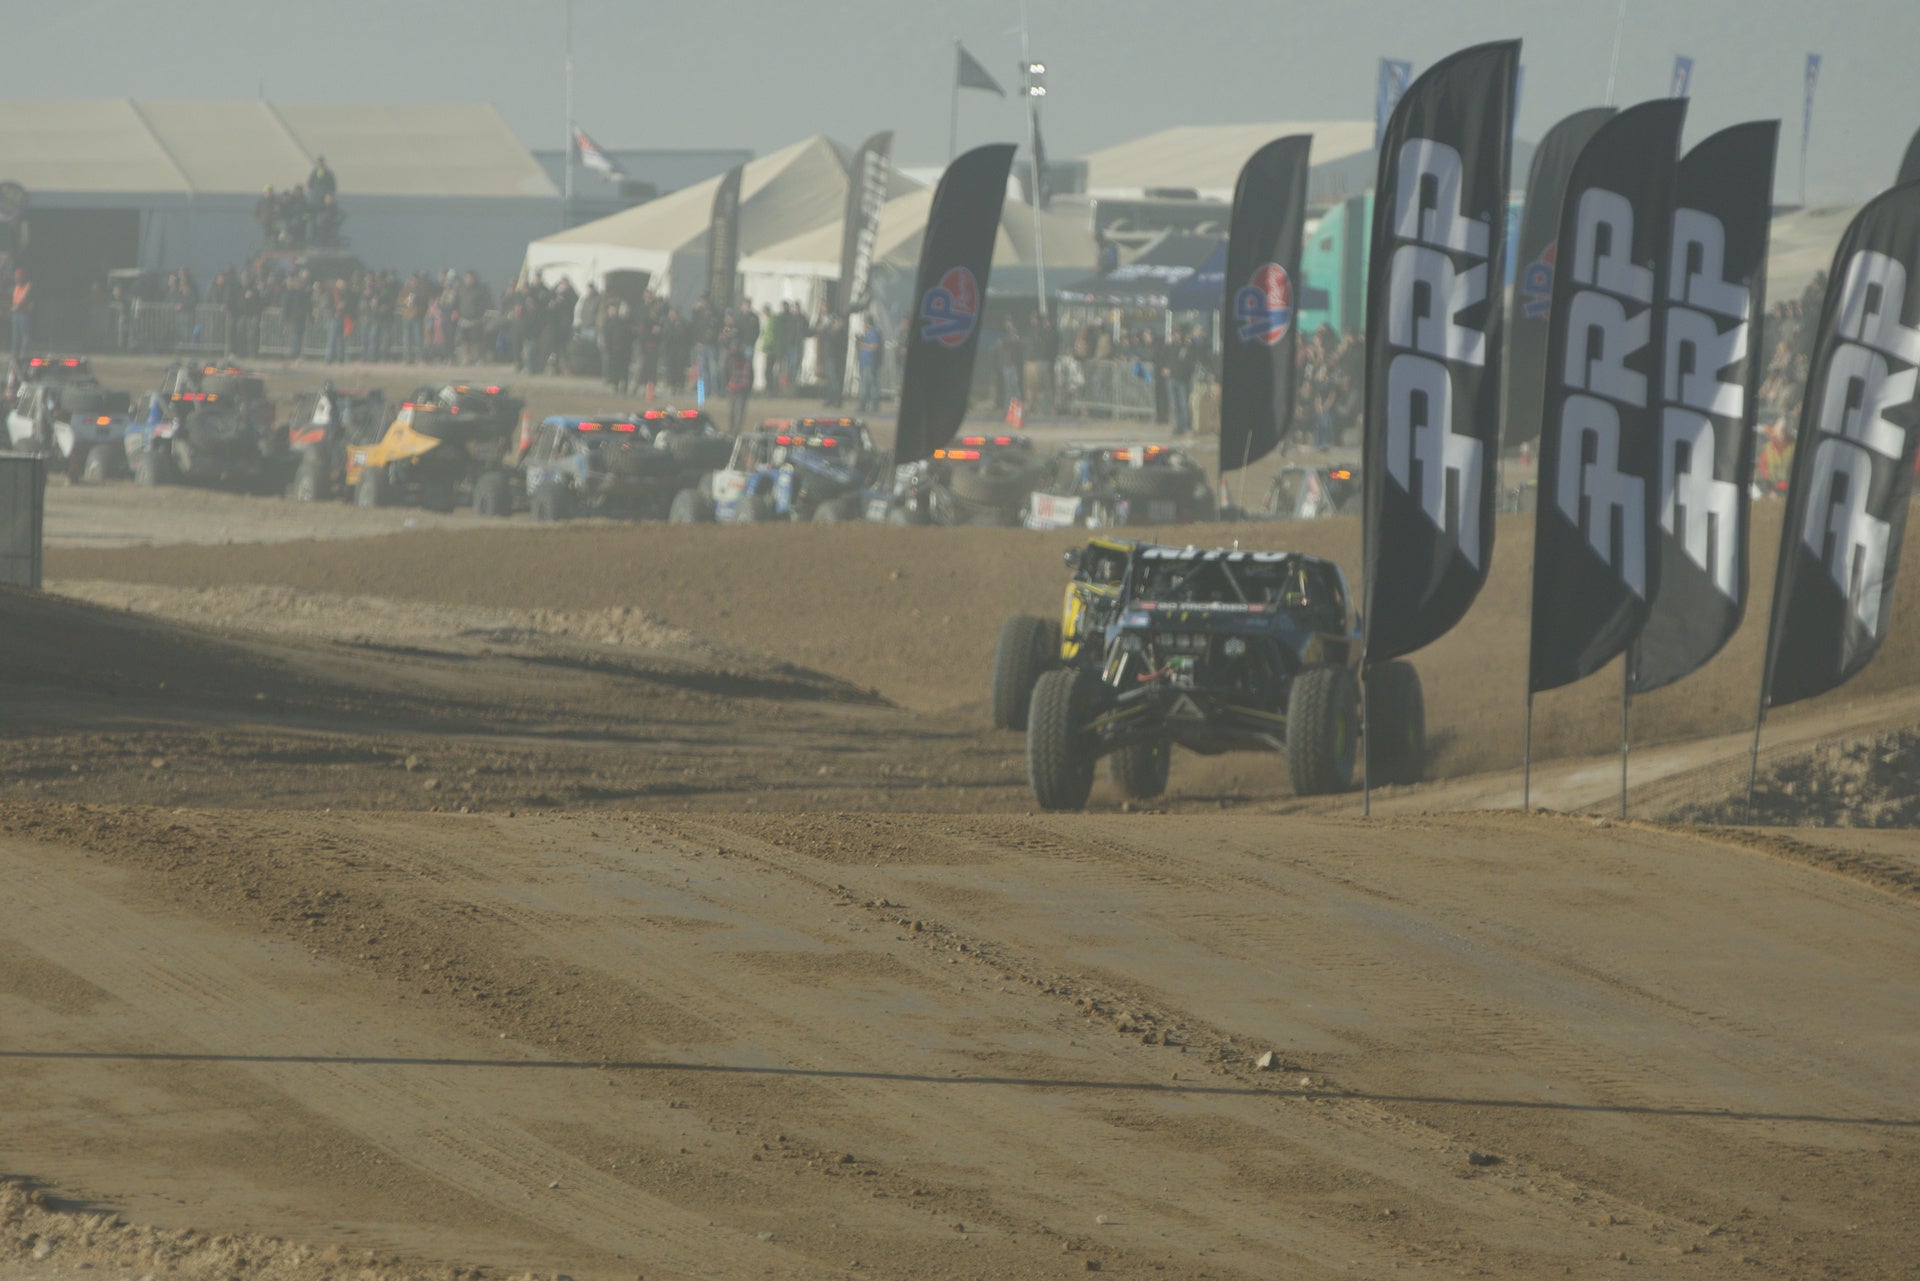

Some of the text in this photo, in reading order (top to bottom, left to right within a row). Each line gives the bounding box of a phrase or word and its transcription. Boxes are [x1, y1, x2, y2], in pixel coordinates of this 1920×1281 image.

[920, 286, 977, 342] VP
[1233, 284, 1292, 342] VP
[1387, 137, 1490, 572] PRP
[1557, 187, 1655, 601] PRP
[1660, 207, 1751, 607] PRP
[1803, 249, 1920, 640] PRP
